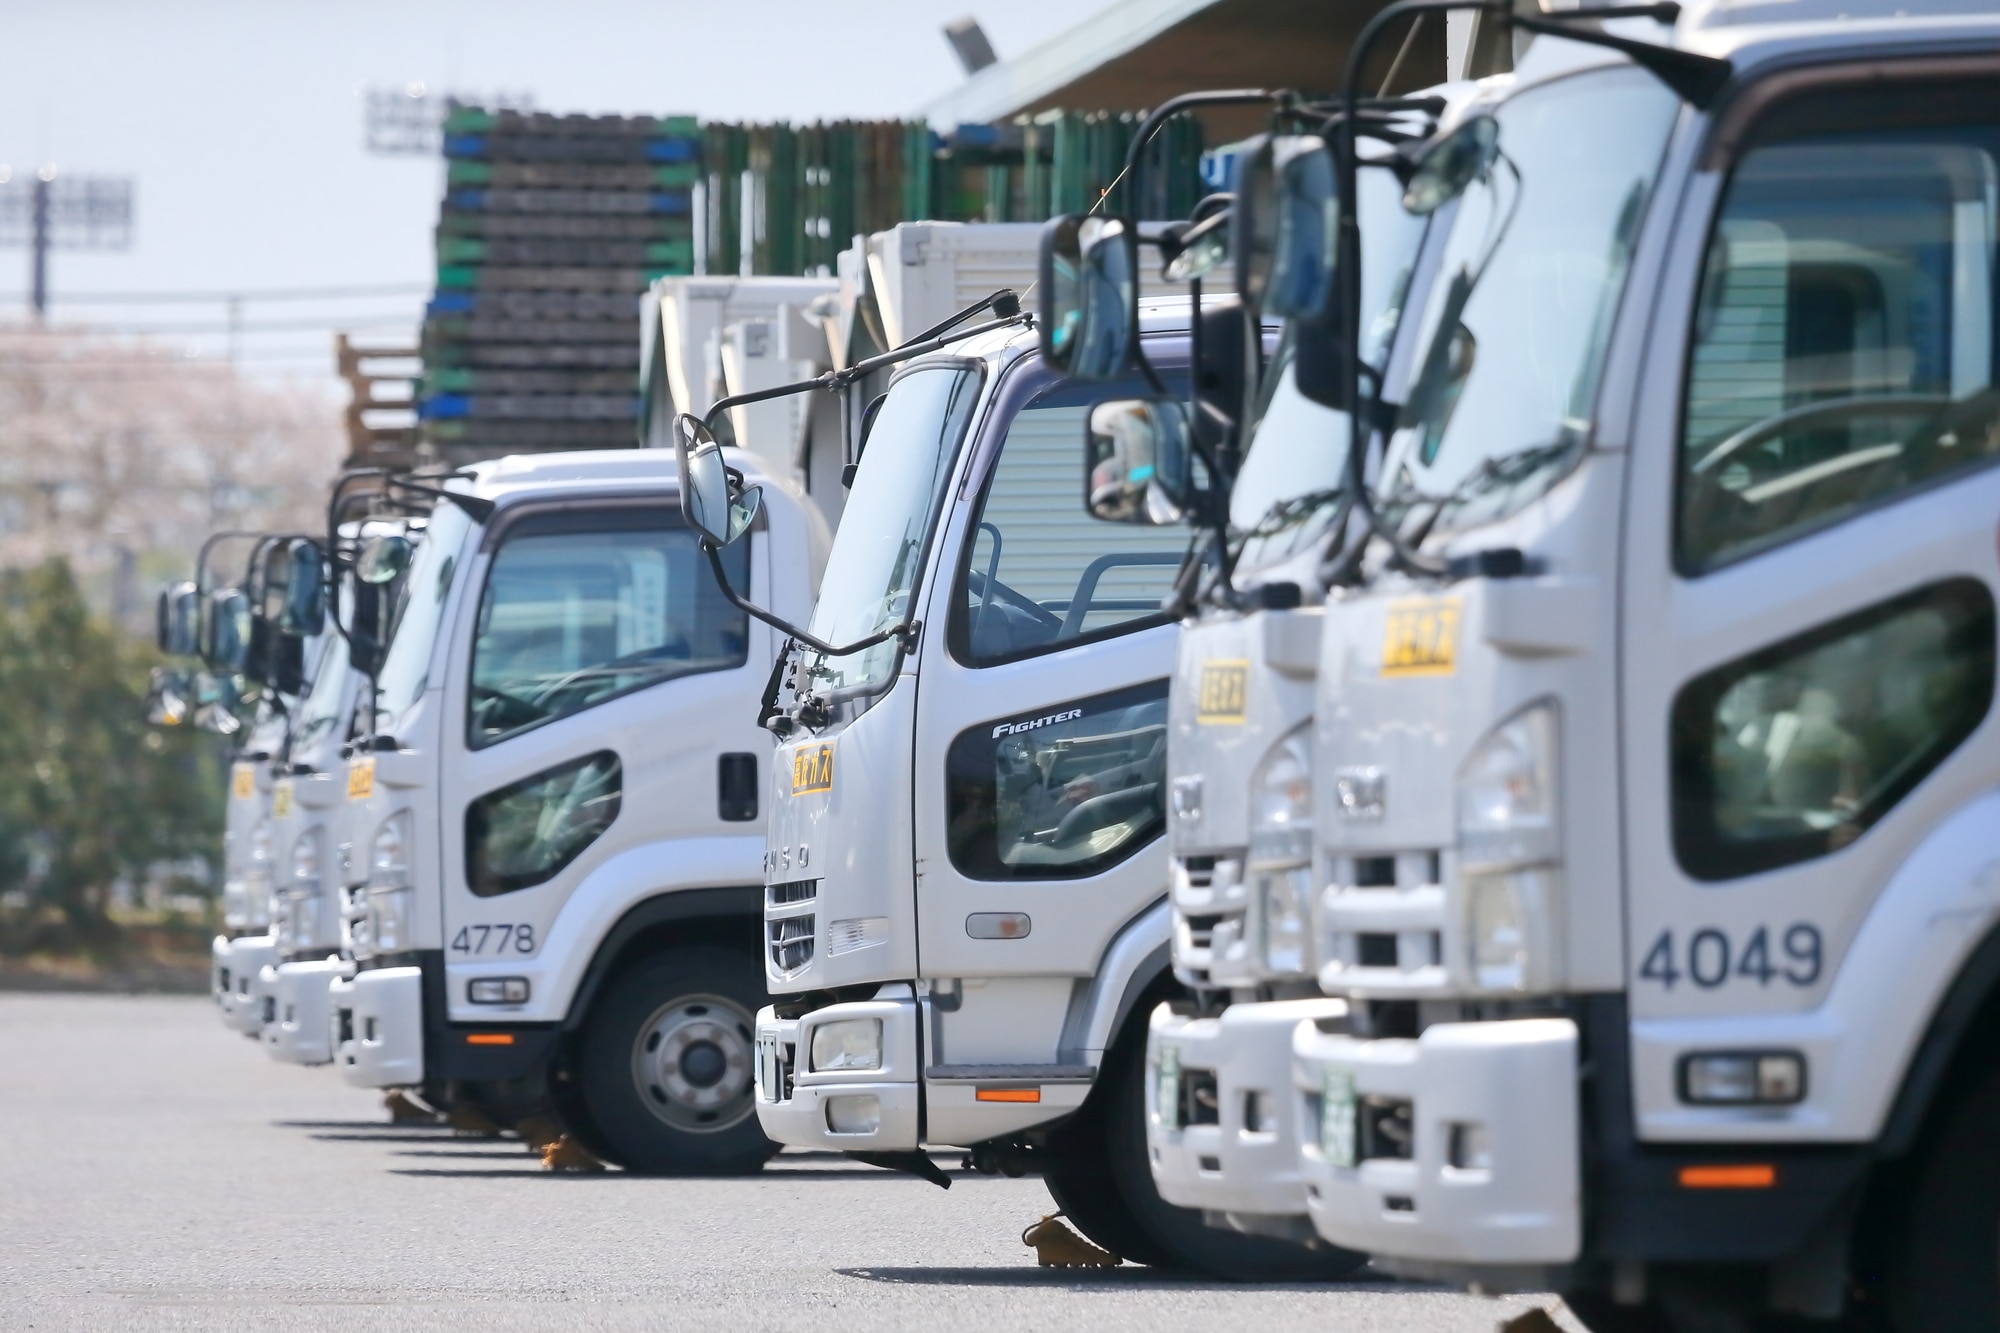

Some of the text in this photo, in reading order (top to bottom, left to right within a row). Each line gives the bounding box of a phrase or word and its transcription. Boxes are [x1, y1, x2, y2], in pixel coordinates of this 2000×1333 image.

[992, 709, 1082, 739] FIGHTER
[793, 750, 831, 788] 高圧ガス
[451, 923, 535, 954] 4778
[1639, 922, 1824, 991] 4049
